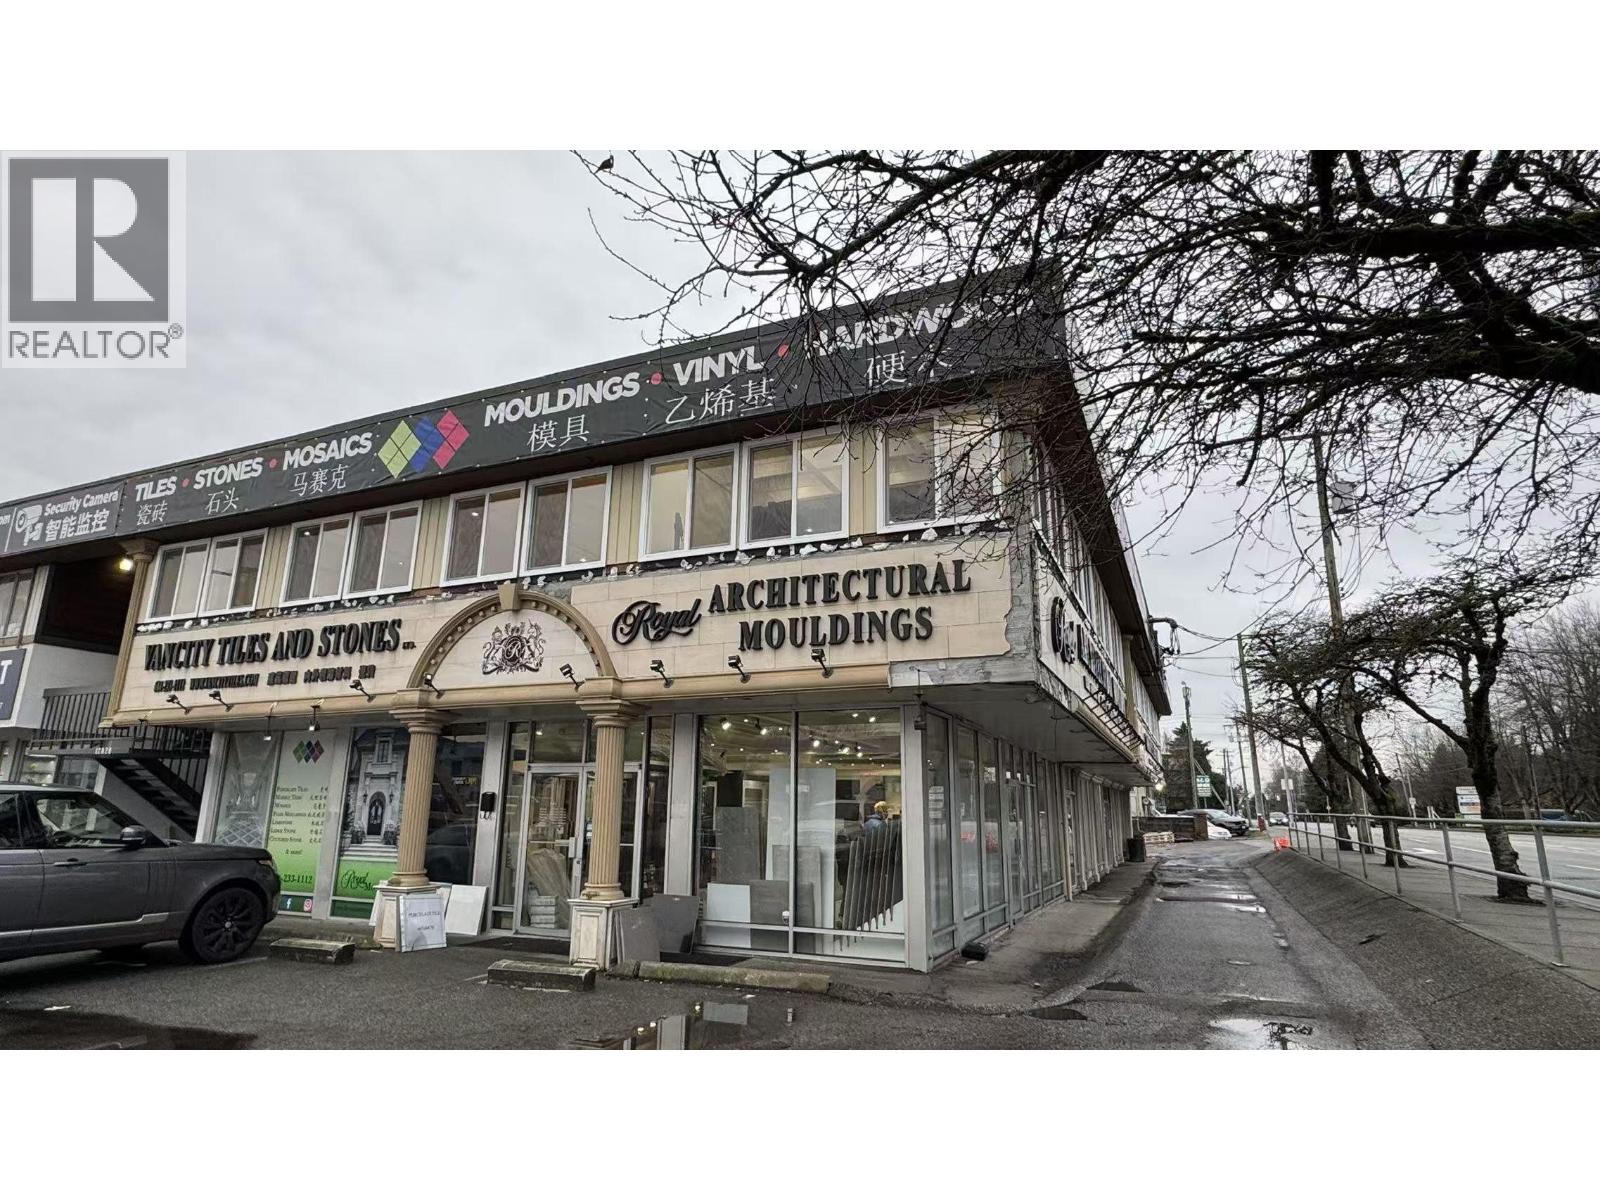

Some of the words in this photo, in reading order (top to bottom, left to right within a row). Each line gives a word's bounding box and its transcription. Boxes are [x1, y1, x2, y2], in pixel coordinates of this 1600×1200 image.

[135, 475, 177, 502] TILES
[193, 457, 263, 490] STONES
[282, 432, 373, 471] MOSAICS
[484, 372, 641, 427] MOULDINGS
[672, 345, 765, 387] VINYL
[136, 499, 168, 526] 瓷砖
[204, 487, 239, 515] 石头
[288, 463, 348, 497] 马赛克
[526, 414, 590, 453] 模具
[665, 376, 776, 425] 乙烯基
[44, 496, 82, 516] Security
[83, 491, 119, 508] Camera
[44, 508, 110, 542] 智能监控
[708, 559, 971, 614] ARCHITECTURAL
[144, 637, 215, 671] VANCITY
[216, 631, 271, 666] TILES
[271, 628, 314, 661] AND
[317, 618, 403, 657] STONES
[612, 598, 702, 646] Royal
[738, 606, 934, 652] MOULDINGS
